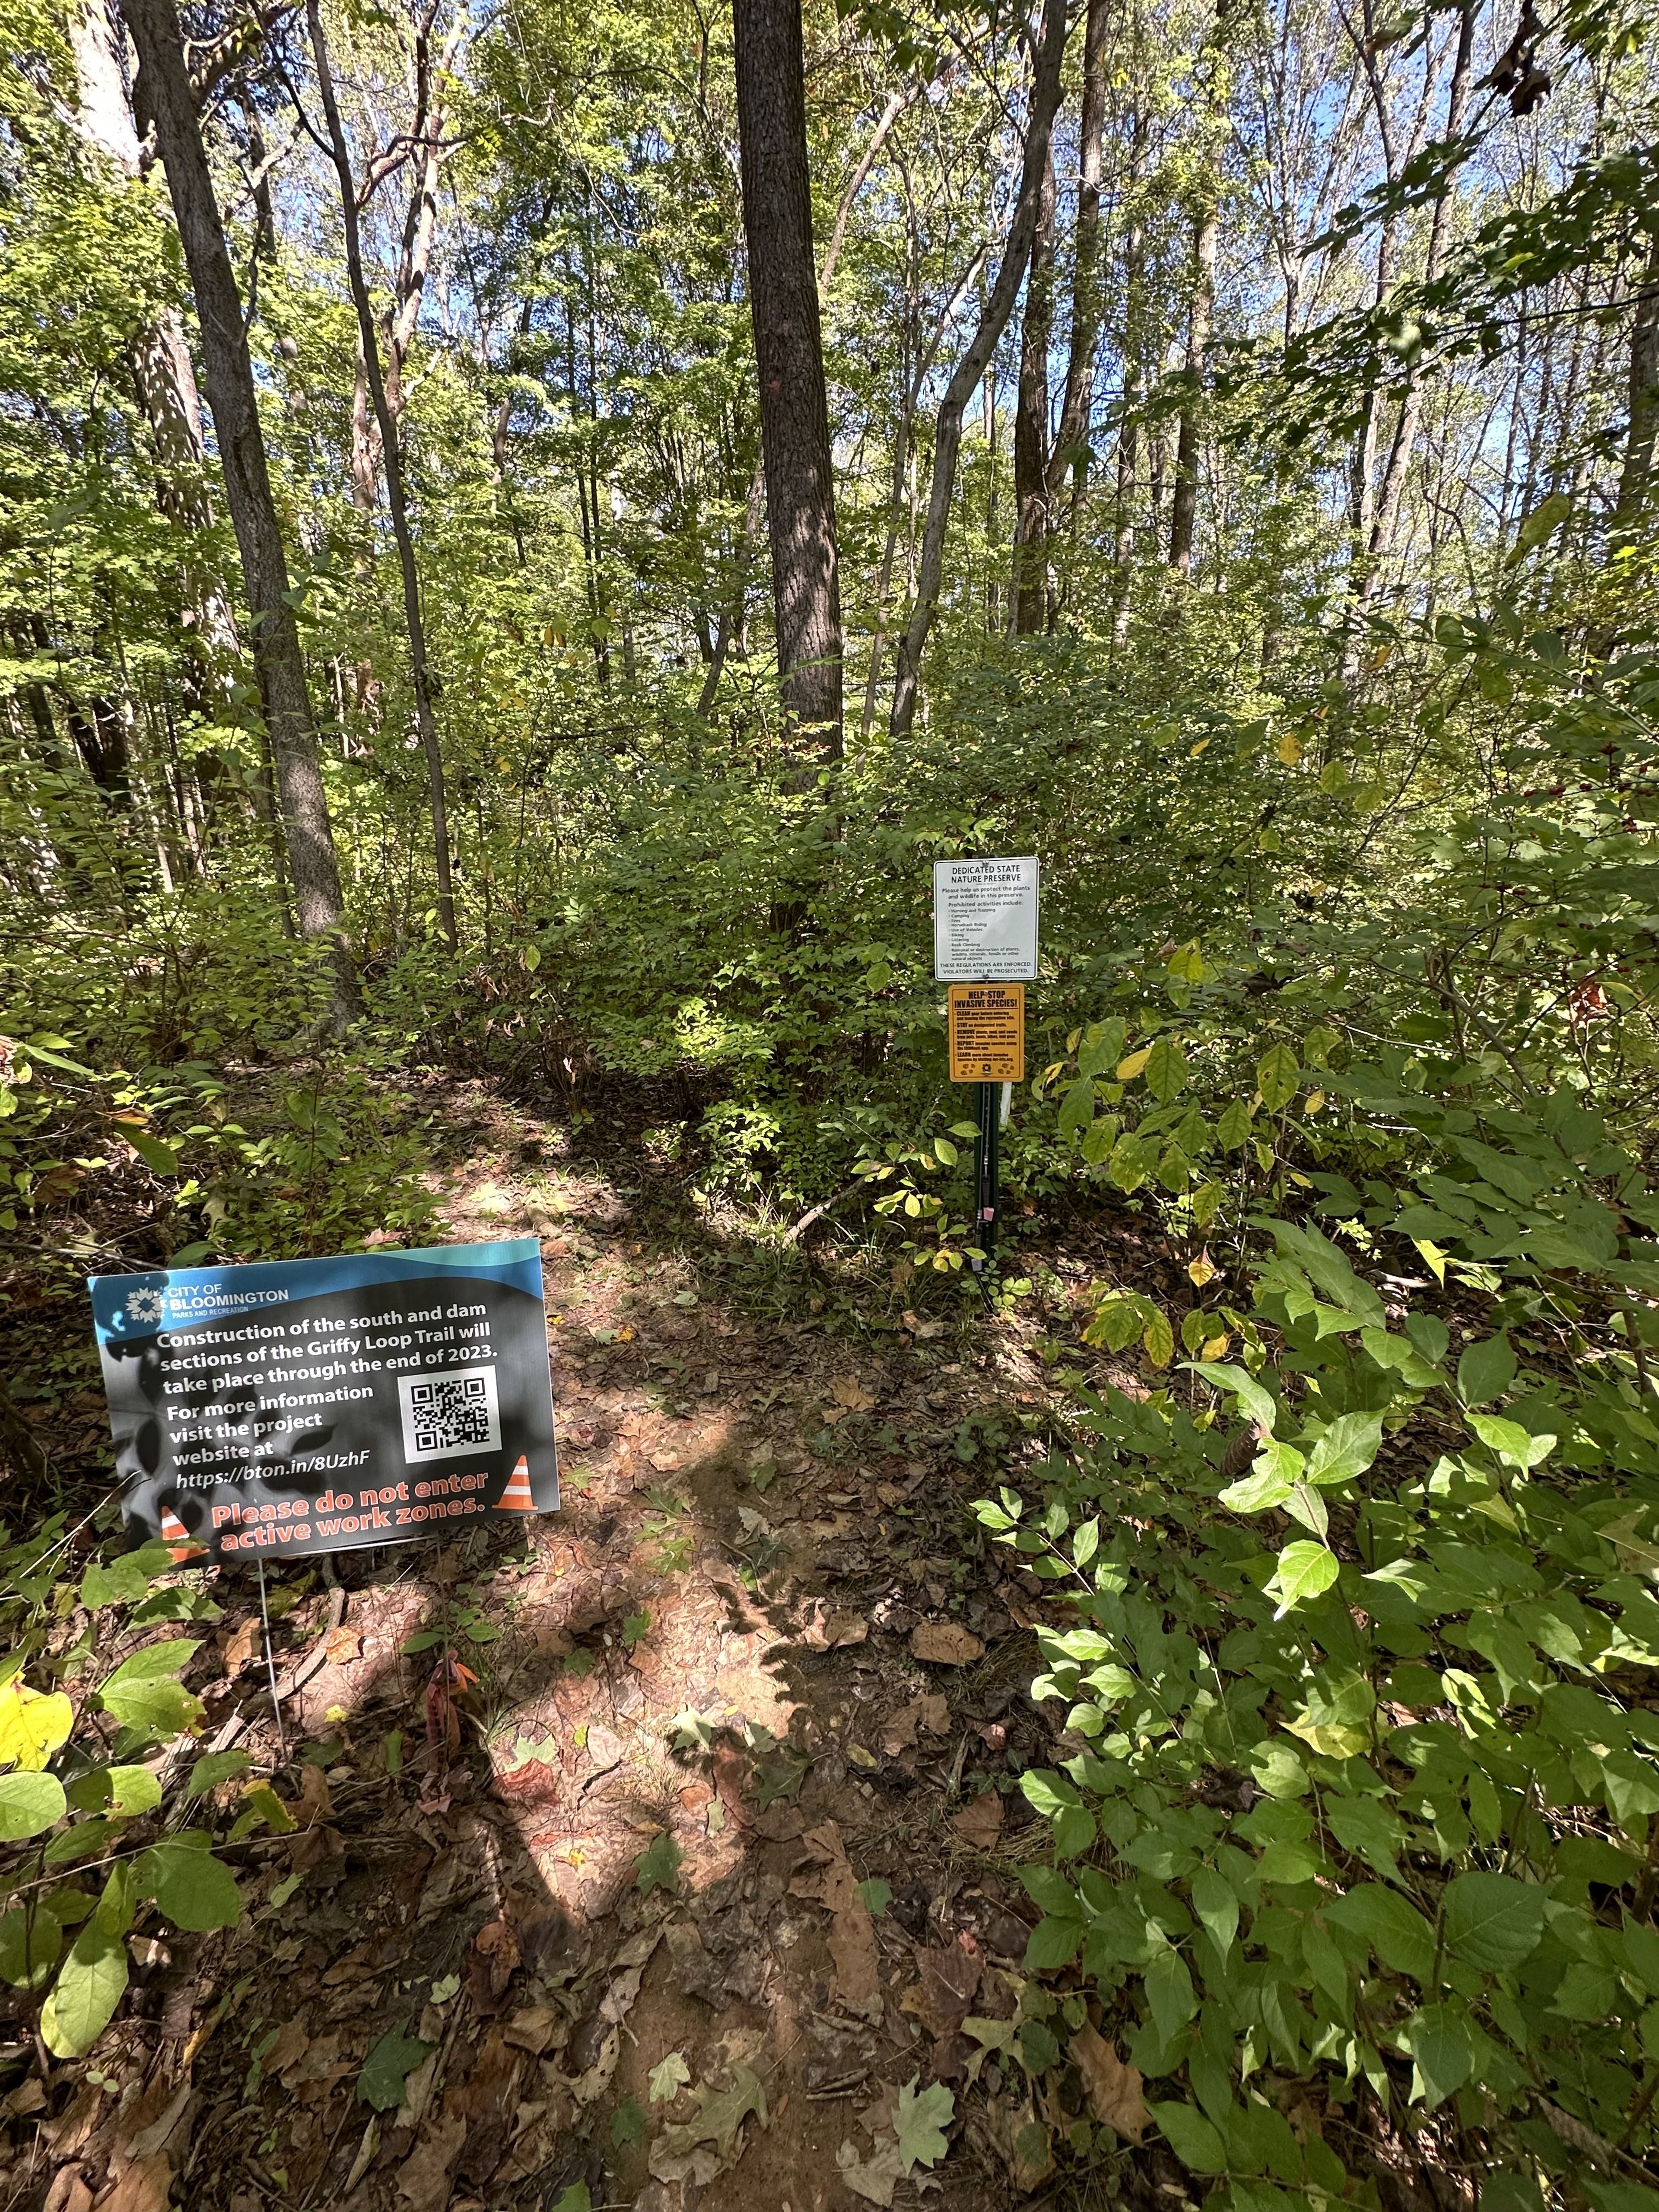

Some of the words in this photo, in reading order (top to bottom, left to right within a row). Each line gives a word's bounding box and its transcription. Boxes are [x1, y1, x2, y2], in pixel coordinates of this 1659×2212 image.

[952, 866, 994, 874] DEDICATED
[984, 874, 1021, 882] PRESERVE
[954, 1000, 985, 1008] INVASIVE
[987, 999, 1017, 1007] SPECIES!
[168, 1285, 199, 1297] CITY
[203, 1284, 222, 1294] OF
[169, 1289, 289, 1311] BLOOMINGTON
[157, 1325, 285, 1348] Construction
[289, 1319, 310, 1335] of
[313, 1317, 345, 1333] the
[350, 1310, 403, 1328] south
[407, 1306, 442, 1323] and
[446, 1303, 486, 1318] dam
[209, 1306, 248, 1315] RECREATION
[161, 1353, 243, 1371] sections
[247, 1346, 267, 1361] of
[270, 1344, 303, 1359] the
[307, 1338, 361, 1356] Griffy
[365, 1334, 412, 1350] Loop
[415, 1326, 454, 1343] Trail
[458, 1322, 490, 1339] will
[163, 1377, 207, 1394] take
[212, 1373, 264, 1392] place
[267, 1360, 346, 1383] through
[350, 1358, 381, 1374] the
[386, 1351, 421, 1369] end
[425, 1348, 444, 1364] of
[448, 1344, 498, 1361] 2023.
[166, 1405, 198, 1421] For
[204, 1400, 256, 1417] more
[260, 1386, 373, 1410] information
[169, 1425, 213, 1443] visit
[216, 1422, 249, 1438] the
[254, 1413, 323, 1437] project
[173, 1446, 250, 1466] website
[254, 1441, 274, 1456] at
[175, 1449, 370, 1489] https://bton.in/8UzhF
[212, 1500, 309, 1528] Please
[315, 1490, 353, 1513] do
[360, 1481, 409, 1506] not
[415, 1472, 488, 1498] enter
[221, 1522, 311, 1551] active
[316, 1506, 392, 1537] work
[396, 1497, 485, 1525] zones.
